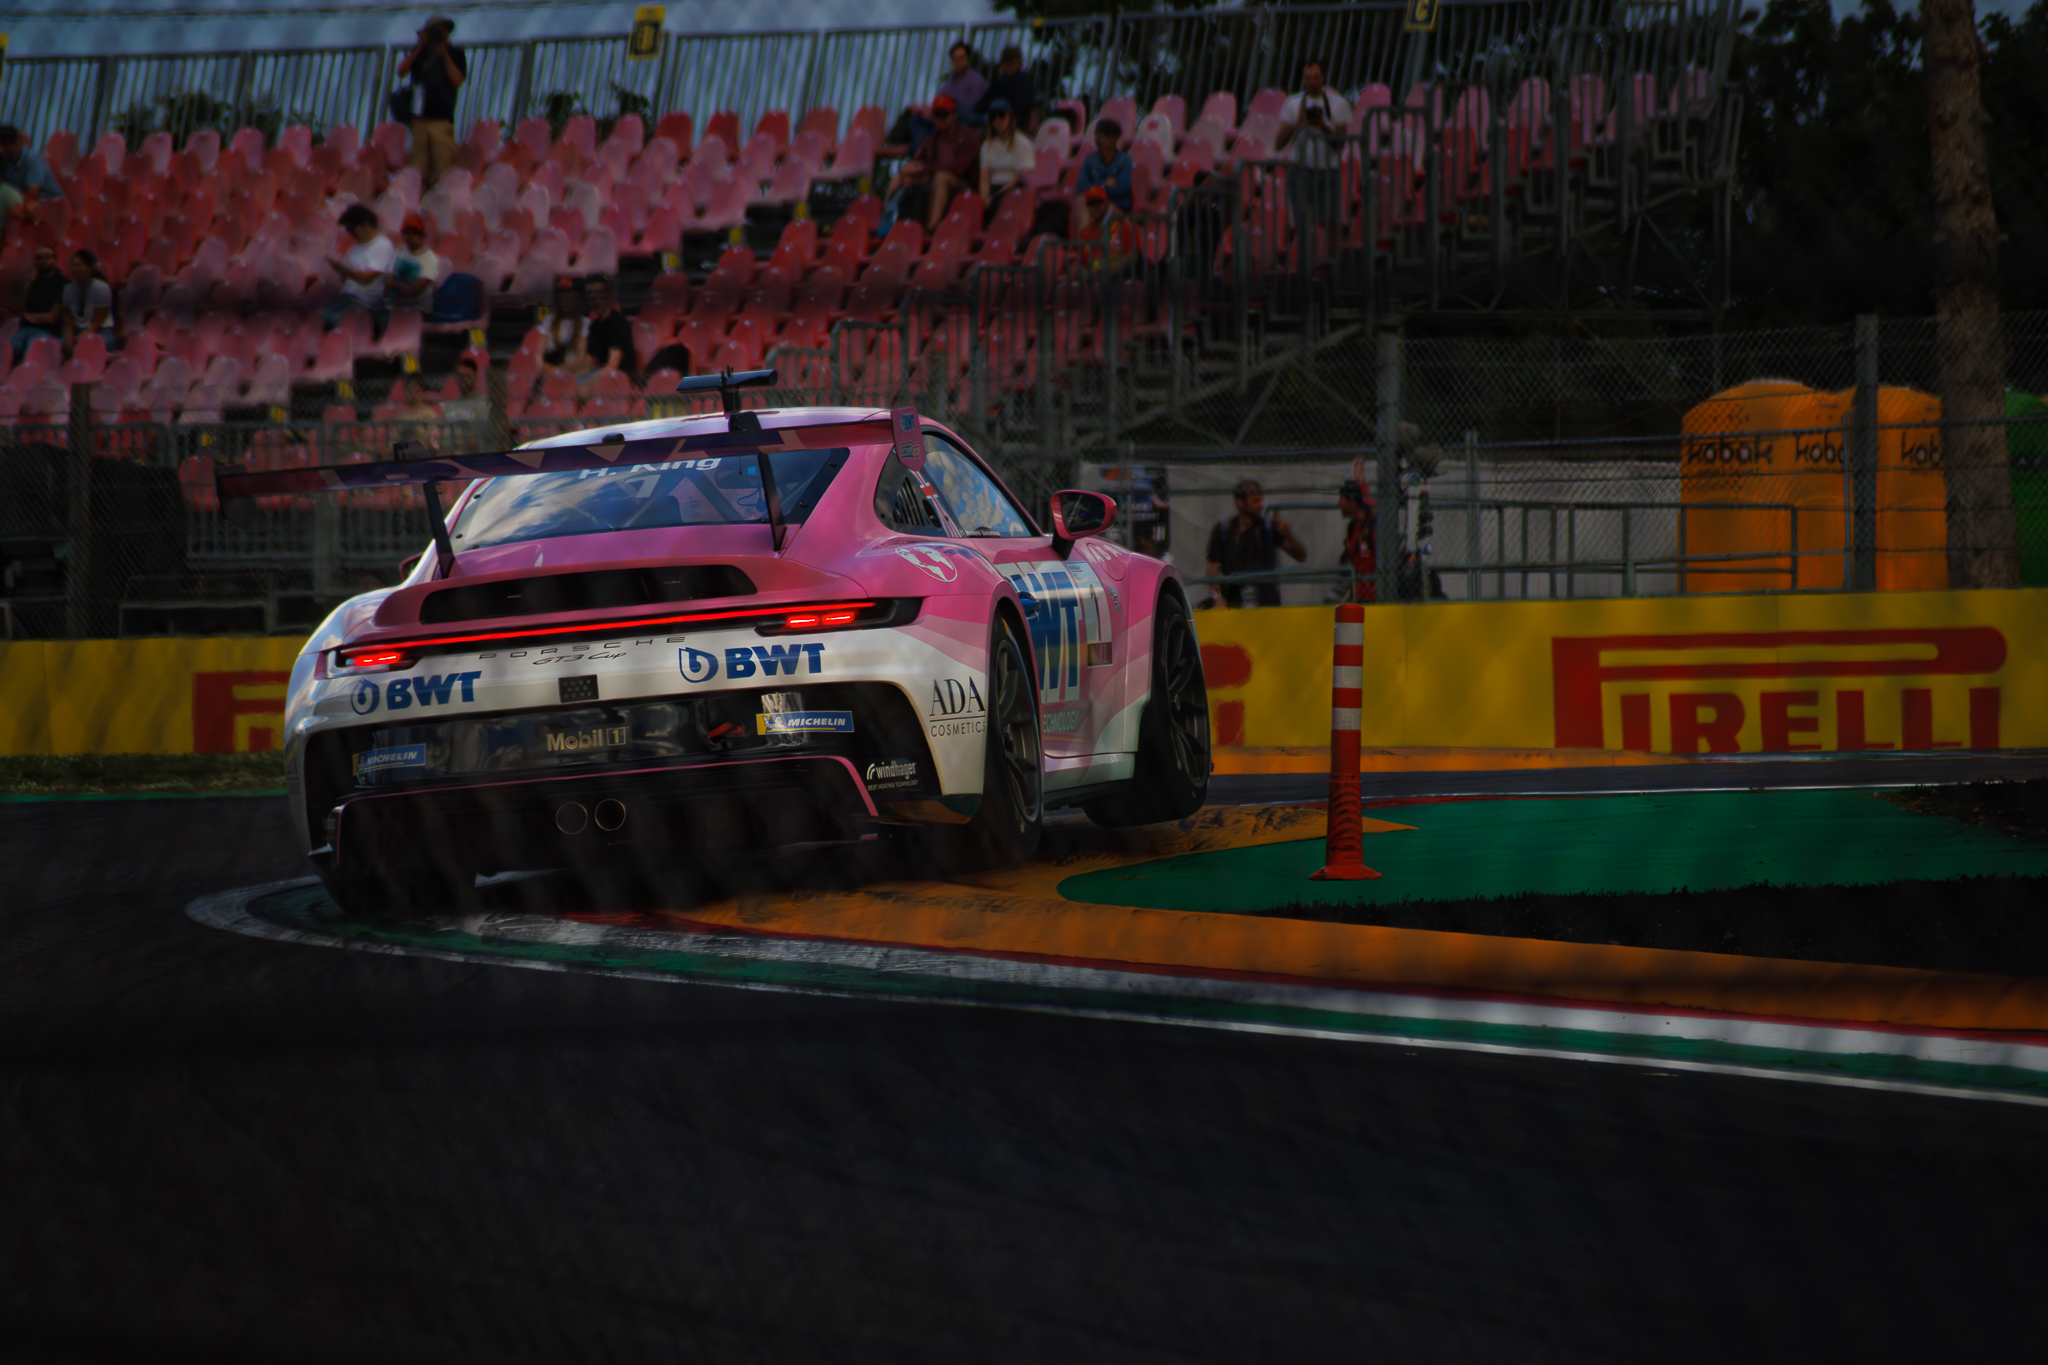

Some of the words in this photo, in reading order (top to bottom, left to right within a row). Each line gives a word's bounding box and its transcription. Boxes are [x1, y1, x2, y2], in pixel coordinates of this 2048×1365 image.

[578, 467, 617, 480] H.
[630, 457, 723, 474] King
[479, 636, 686, 660] PORSCHE
[532, 654, 584, 666] GT3
[588, 651, 627, 660] Cup
[725, 643, 825, 680] BWT
[386, 670, 482, 711] BWT
[929, 676, 986, 716] ADA
[1552, 626, 2007, 753] PIRELLI
[787, 717, 846, 727] MICHELIN
[930, 721, 986, 737] COSMETICS
[1043, 710, 1079, 733] ECHNOLOGY
[546, 728, 604, 752] Mobil
[366, 751, 418, 764] MICHELIN
[876, 760, 916, 780] windhager
